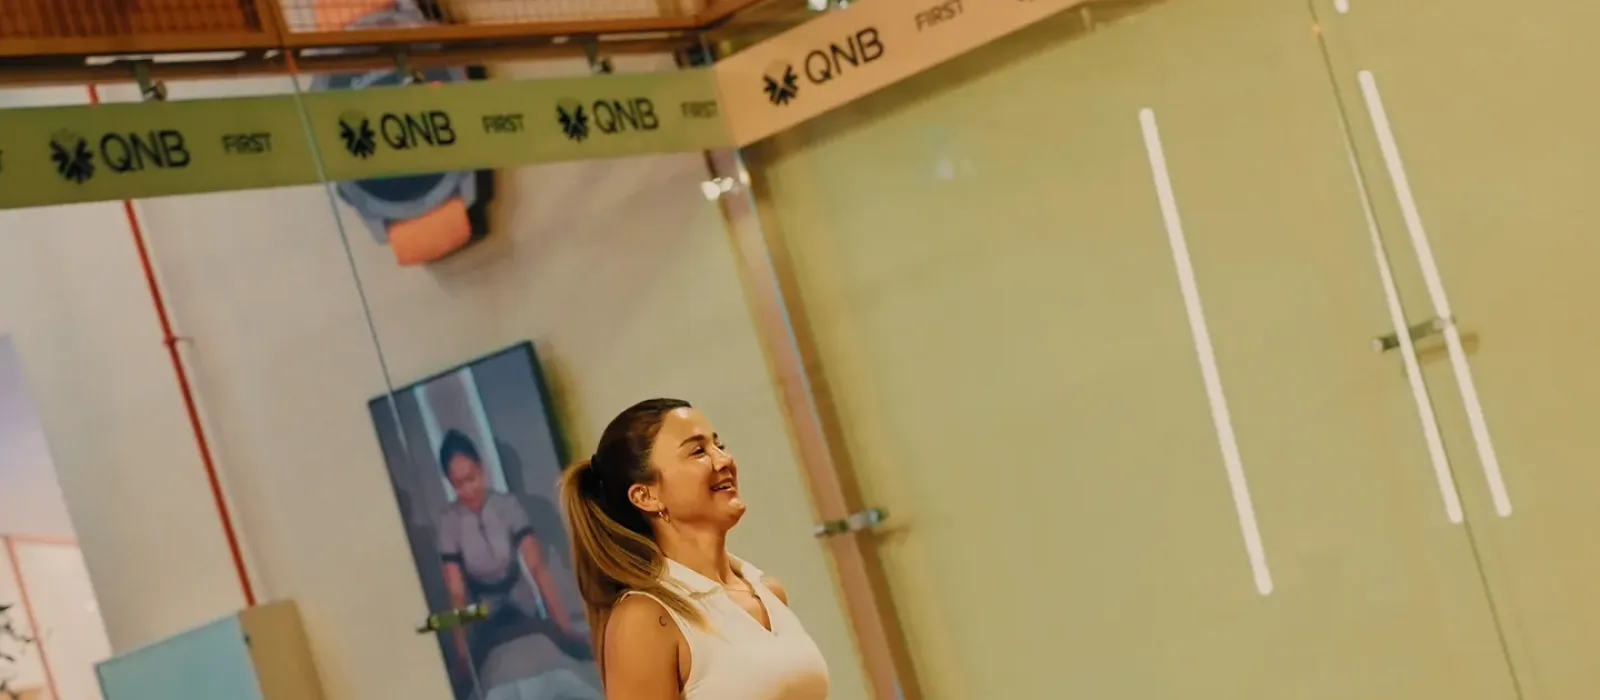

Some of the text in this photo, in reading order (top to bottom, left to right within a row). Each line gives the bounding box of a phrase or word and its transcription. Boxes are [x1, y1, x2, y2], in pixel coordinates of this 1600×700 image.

[805, 0, 964, 85] QNB FIRST
[379, 110, 457, 150] QNB
[482, 113, 525, 135] FIRST
[594, 96, 660, 134] QNB
[99, 129, 272, 173] QNB FIRST
